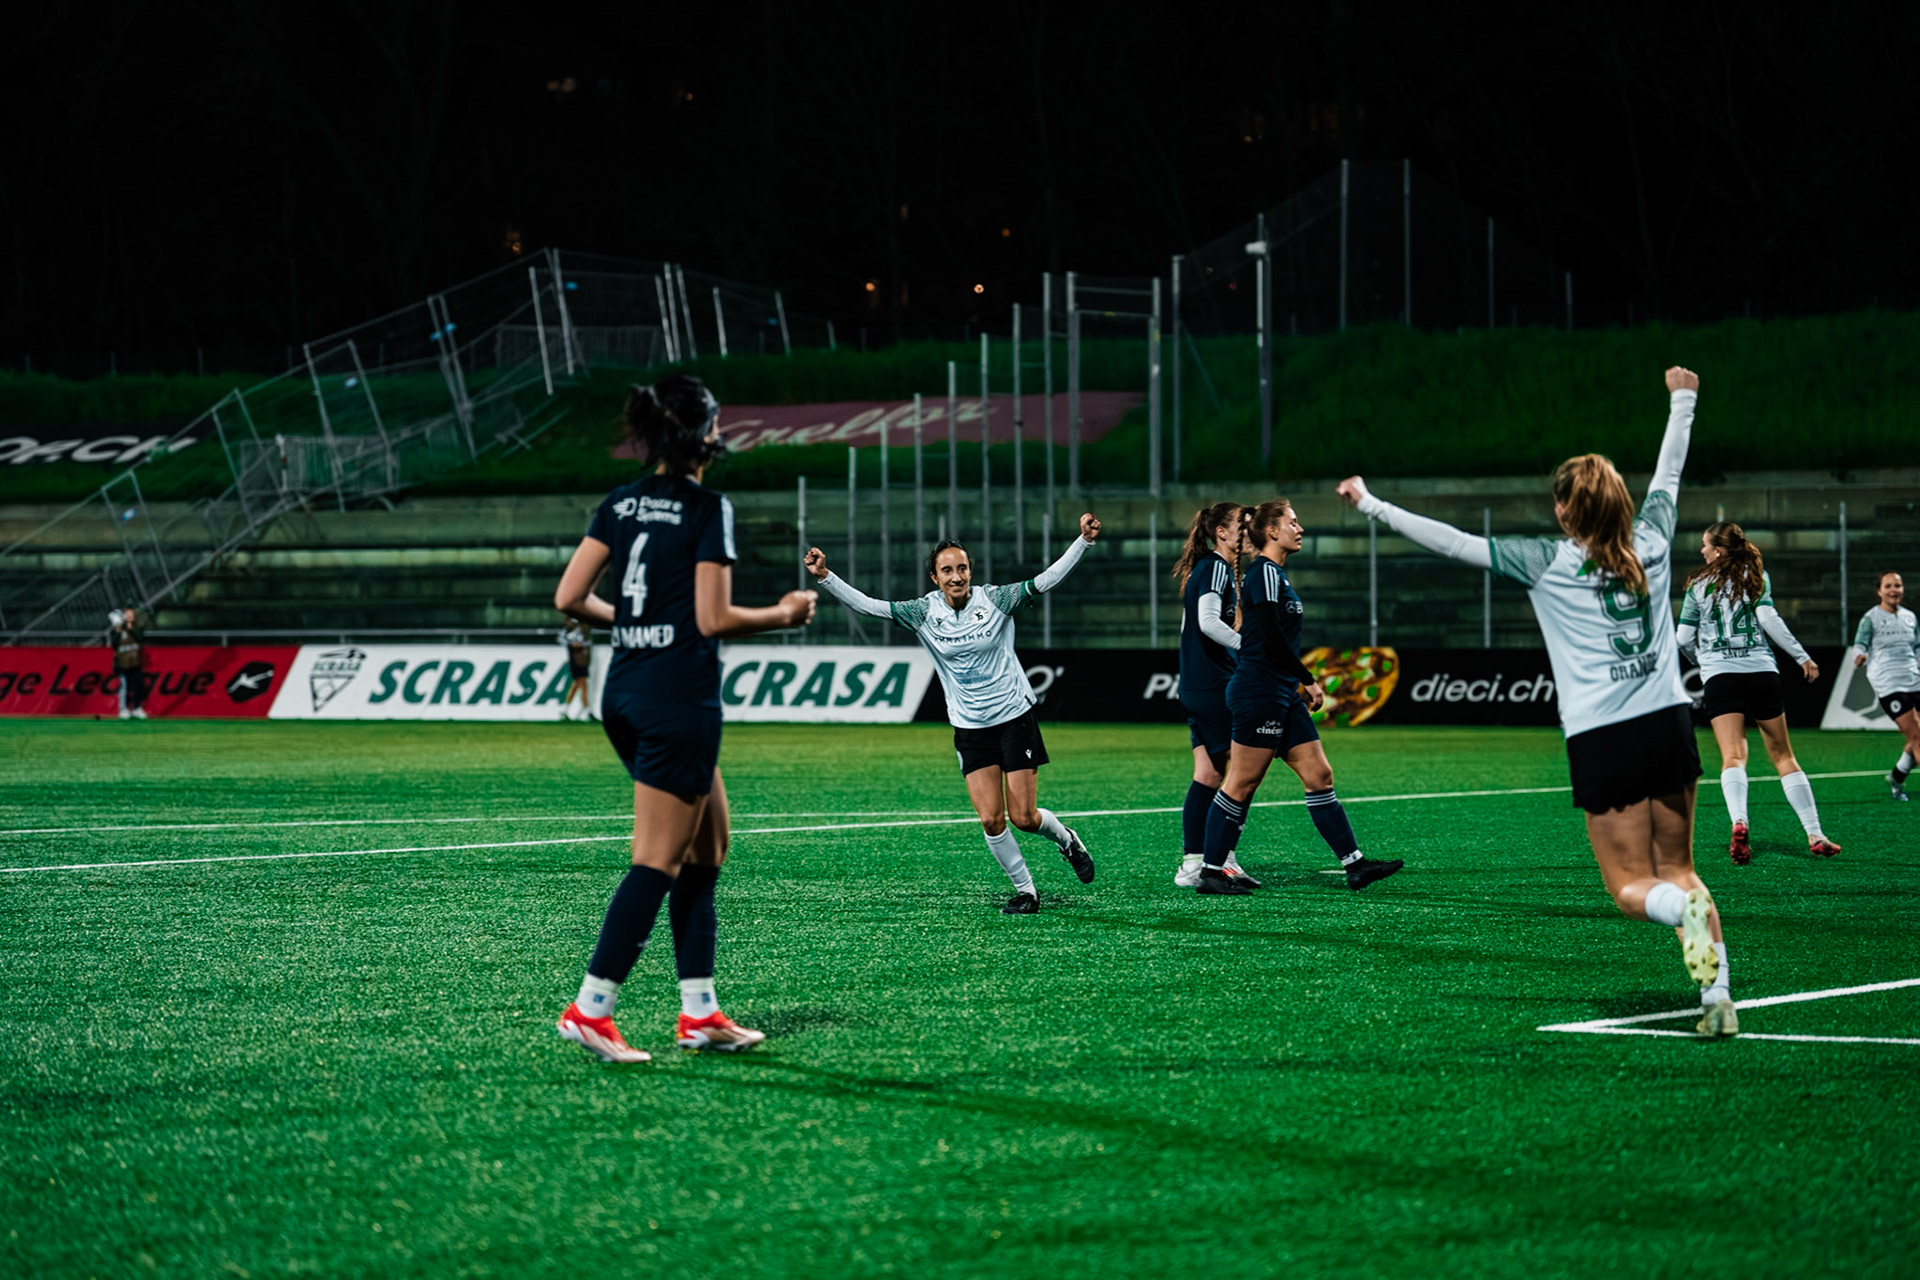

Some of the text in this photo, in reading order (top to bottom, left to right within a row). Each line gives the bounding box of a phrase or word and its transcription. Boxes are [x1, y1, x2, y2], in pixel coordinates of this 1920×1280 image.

[622, 532, 649, 617] 4
[1598, 578, 1655, 661] 9
[1709, 602, 1758, 650] 14
[368, 659, 572, 705] SCRASA
[721, 660, 911, 707] CRASA
[1410, 673, 1555, 702] dieci.ch
